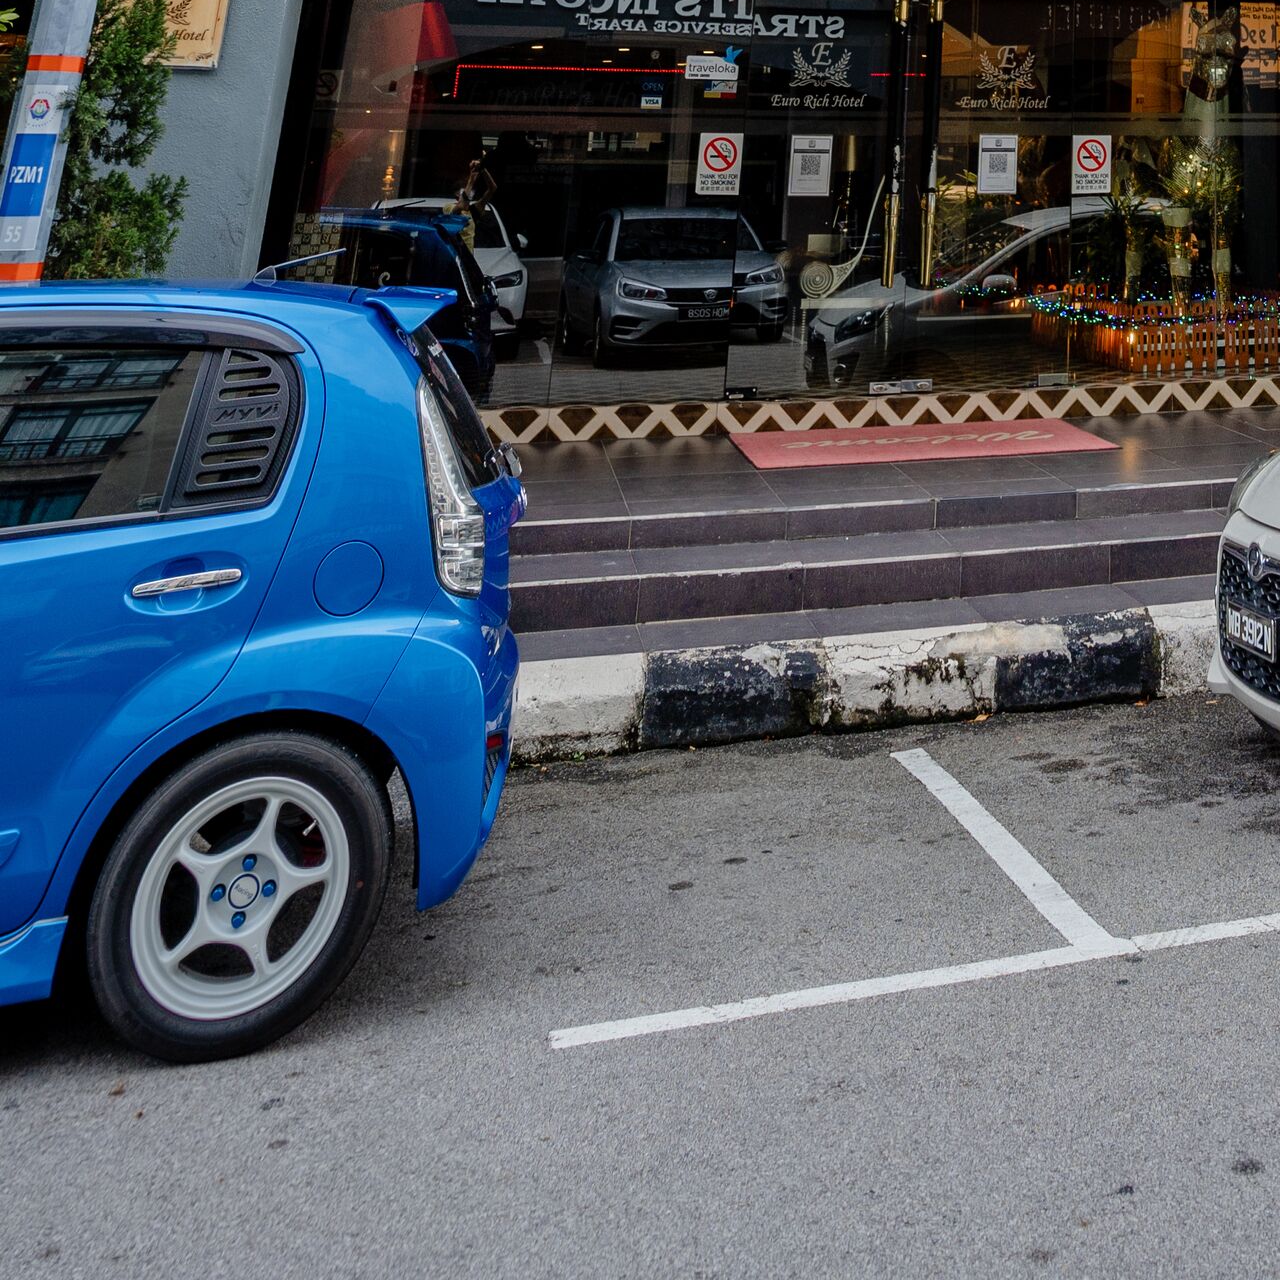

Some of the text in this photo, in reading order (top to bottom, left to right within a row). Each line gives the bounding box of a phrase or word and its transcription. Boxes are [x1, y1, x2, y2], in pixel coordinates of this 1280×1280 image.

[174, 29, 210, 41] Hotel
[688, 63, 737, 74] traveloka
[771, 93, 868, 109] Euro Rich Hotel
[960, 95, 1051, 109] Euro Rich Hotel
[9, 166, 44, 183] PZM1
[5, 226, 21, 243] 55
